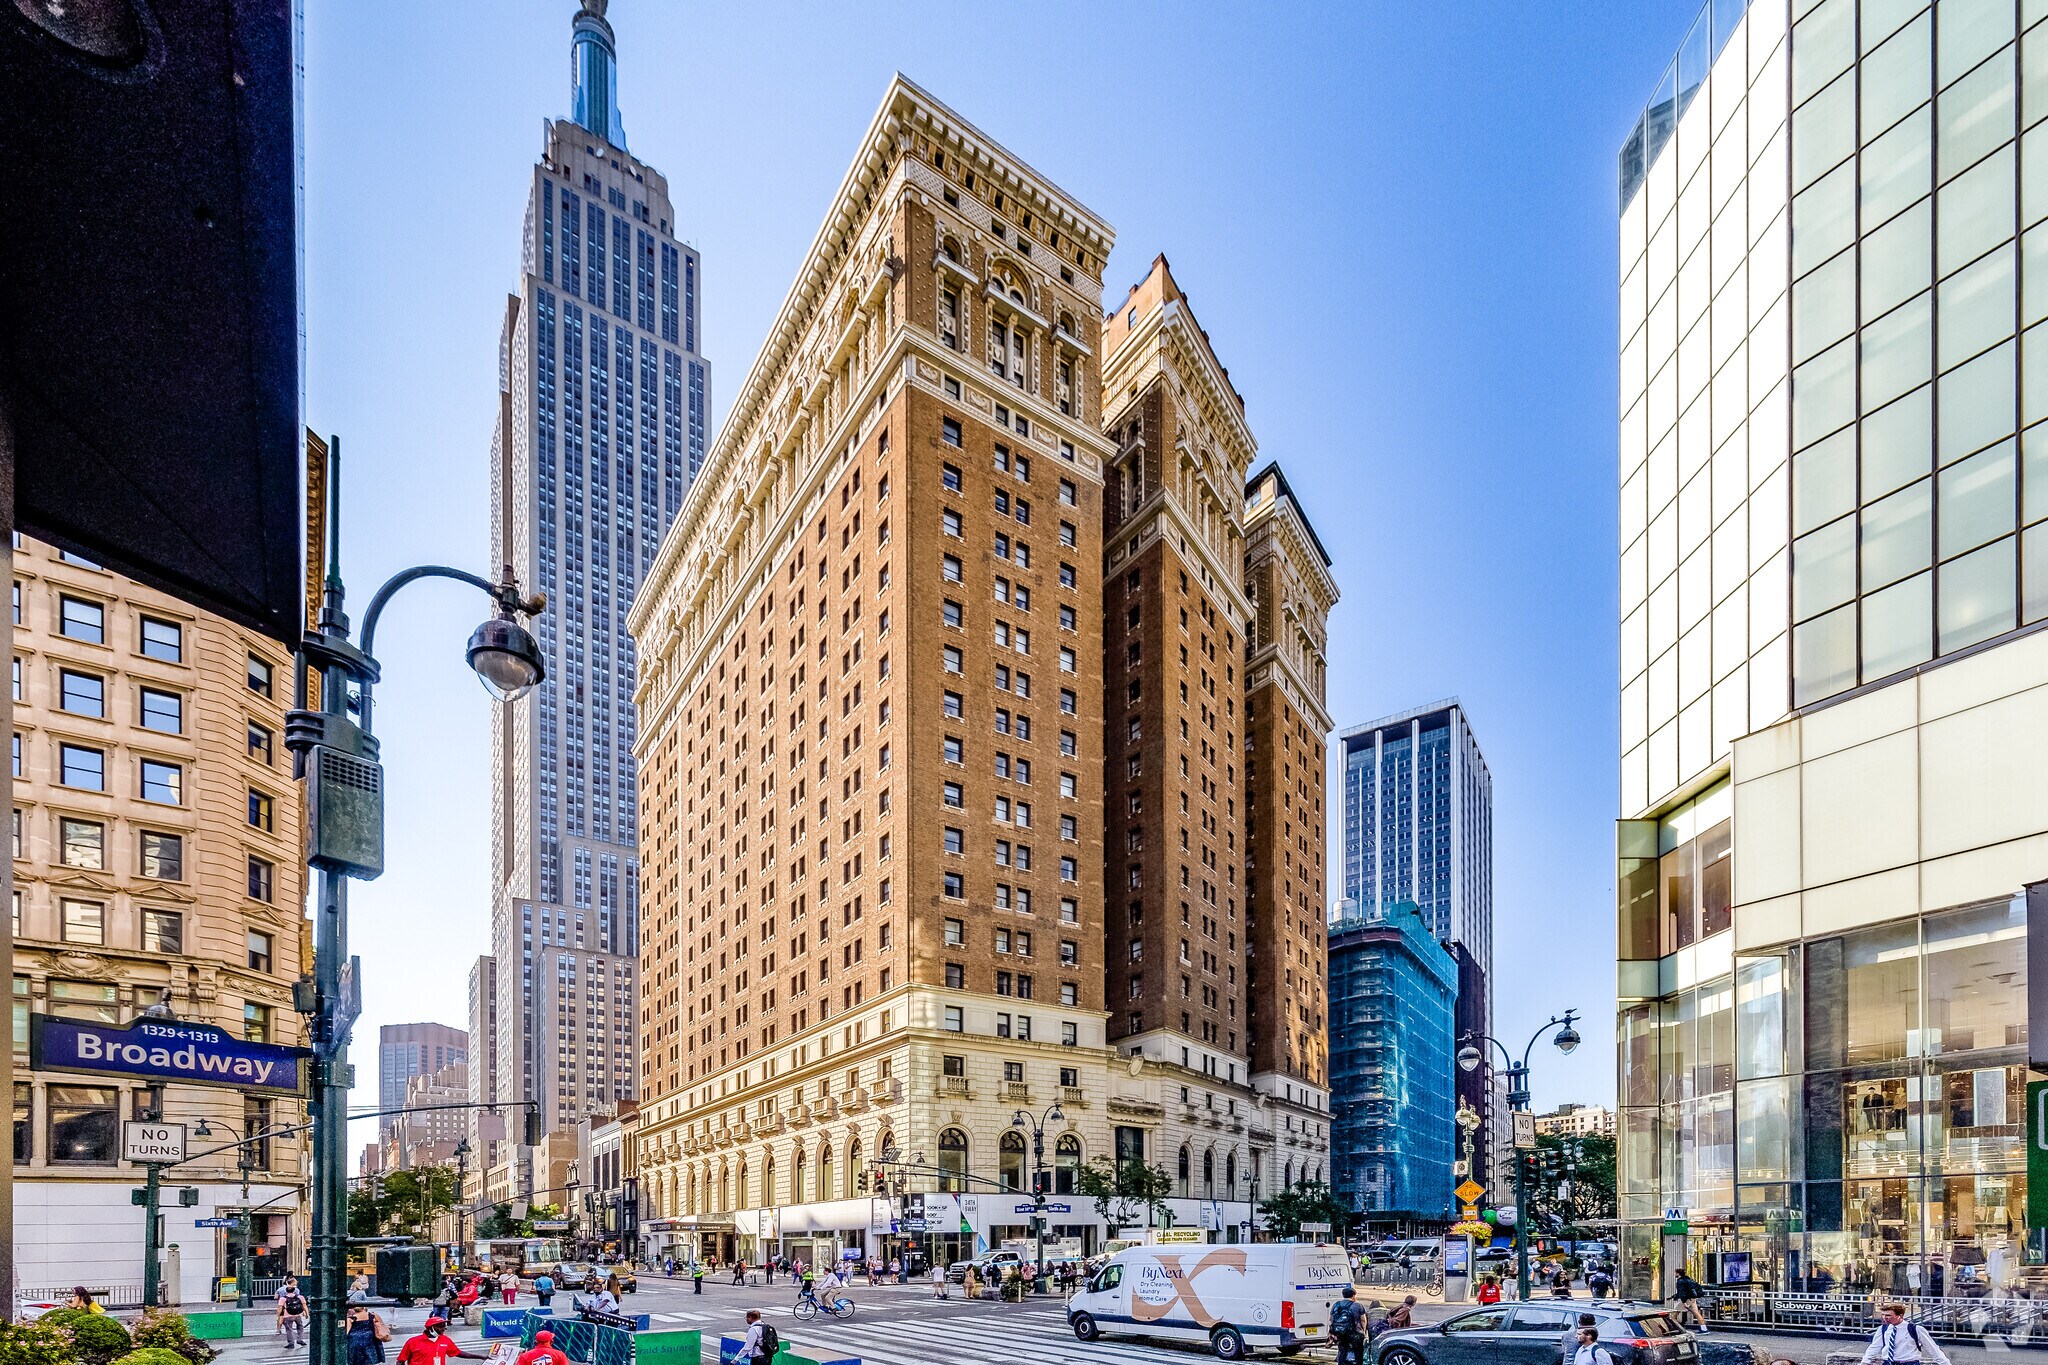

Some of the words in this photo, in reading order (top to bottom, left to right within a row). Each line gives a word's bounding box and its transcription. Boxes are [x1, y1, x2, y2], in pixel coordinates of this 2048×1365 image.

[141, 1024, 176, 1038] 1329
[188, 1030, 219, 1044] 1313
[77, 1032, 275, 1084] Broadway
[1519, 1119, 1530, 1130] NO
[141, 1128, 169, 1141] NO
[1515, 1133, 1534, 1143] TURNS
[129, 1144, 180, 1156] TURNS
[1141, 1266, 1185, 1281] ByNext
[1307, 1266, 1342, 1281] ByNext
[1140, 1281, 1149, 1289] Dry
[1774, 1301, 1853, 1312] Subway-PATH
[490, 1319, 517, 1327] Herald
[661, 1344, 695, 1354] Square
